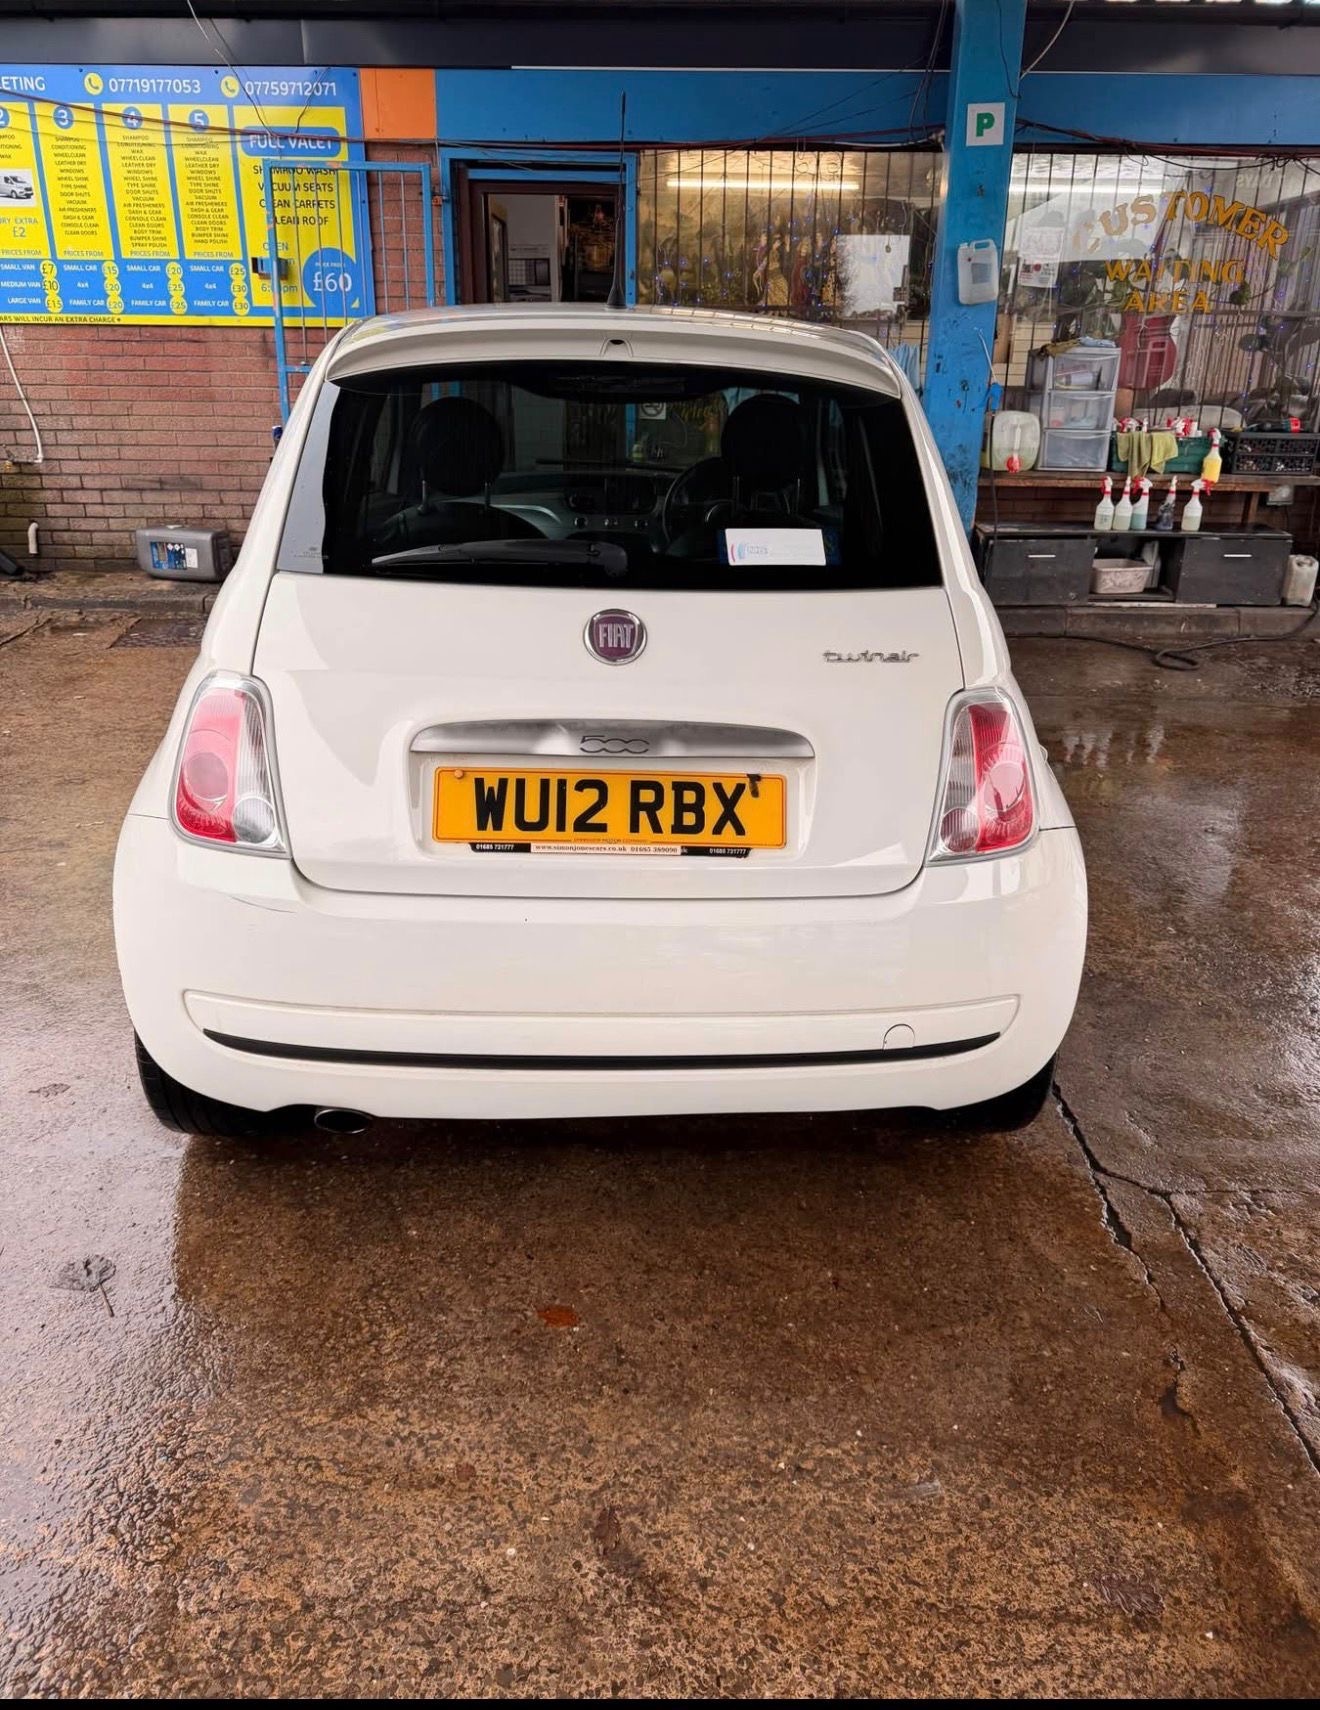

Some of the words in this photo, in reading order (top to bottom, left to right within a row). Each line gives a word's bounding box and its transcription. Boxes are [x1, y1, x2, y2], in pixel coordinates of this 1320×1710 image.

[0, 77, 46, 92] ETING
[108, 78, 201, 94] 07719177053
[244, 81, 337, 96] 07759712071
[58, 109, 68, 126] 3
[125, 110, 137, 127] 4
[194, 112, 204, 126] 5
[976, 112, 995, 137] P
[250, 134, 285, 149] FULL
[288, 136, 332, 150] VALET
[258, 182, 301, 192] VCUUM
[304, 182, 334, 192] SEATS
[259, 200, 290, 208] CEAN
[275, 216, 300, 225] LEAN
[302, 216, 329, 225] ROOF
[13, 226, 26, 238] £2
[263, 242, 288, 251] OEN
[42, 264, 54, 274] £7
[1104, 259, 1245, 284] WAITING
[42, 280, 58, 290] £10
[313, 271, 352, 292] £60
[47, 300, 61, 308] £15
[1123, 289, 1212, 314] AREA
[599, 623, 634, 648] FIAT
[822, 650, 920, 663] twinair
[580, 735, 650, 754] 500
[474, 777, 609, 833] WU12
[629, 780, 747, 836] RBX
